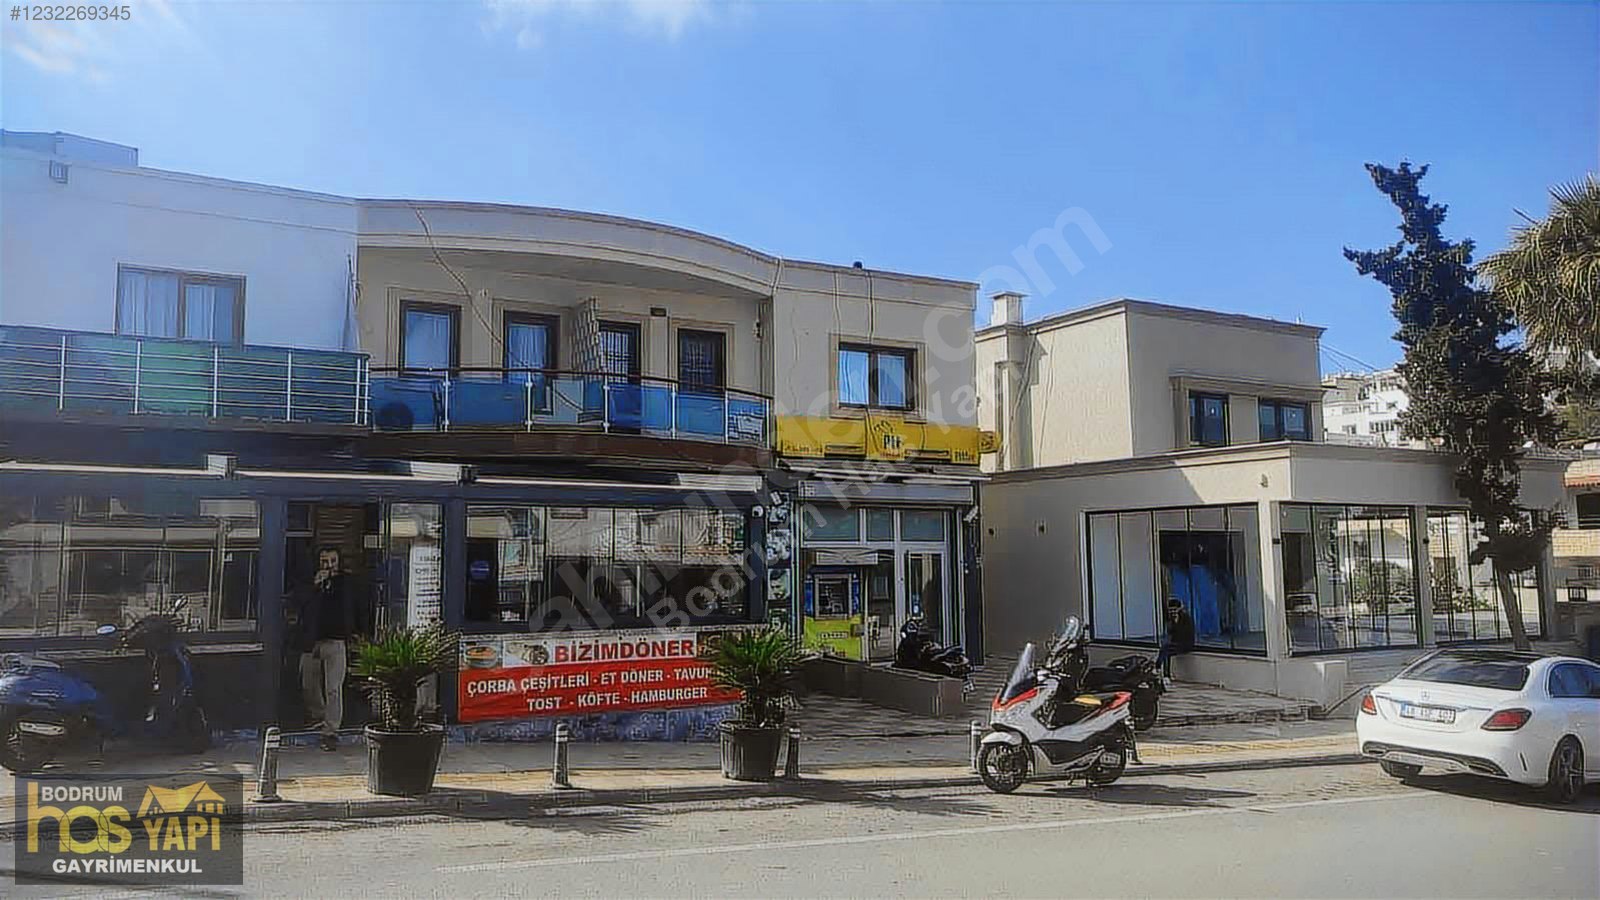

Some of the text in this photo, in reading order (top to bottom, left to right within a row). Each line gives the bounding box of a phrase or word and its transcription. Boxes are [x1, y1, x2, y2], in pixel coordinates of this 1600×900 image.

[555, 637, 694, 663] BİZİMDÖNER
[467, 679, 516, 698] ÇORBA
[520, 671, 590, 696] ÇEŞİTLERİ
[601, 672, 617, 688] ET
[527, 697, 563, 711] TOST
[577, 691, 620, 708] KÖFTE
[630, 687, 708, 705] HAMBURGER
